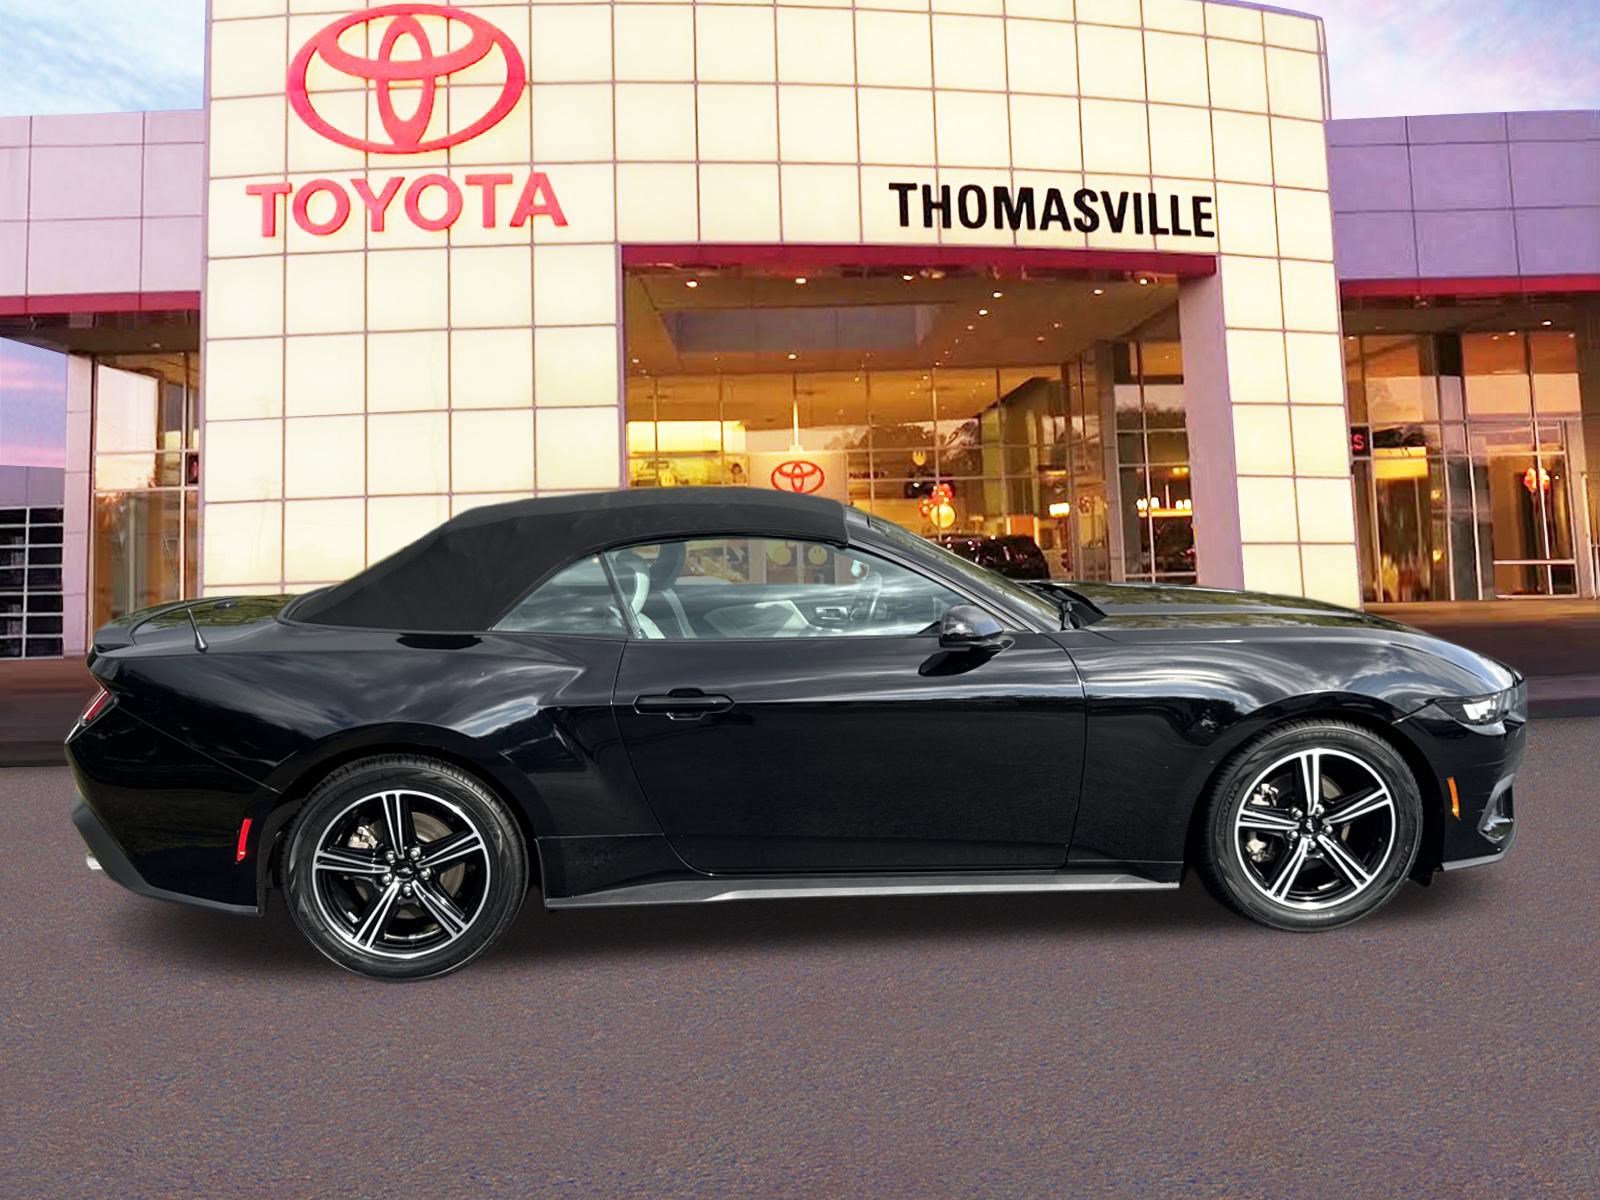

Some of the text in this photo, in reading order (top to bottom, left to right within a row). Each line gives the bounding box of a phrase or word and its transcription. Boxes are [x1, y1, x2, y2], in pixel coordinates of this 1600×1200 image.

[246, 172, 568, 237] TOYOTA
[889, 182, 1216, 237] THOMASVILLE
[1351, 433, 1364, 450] S
